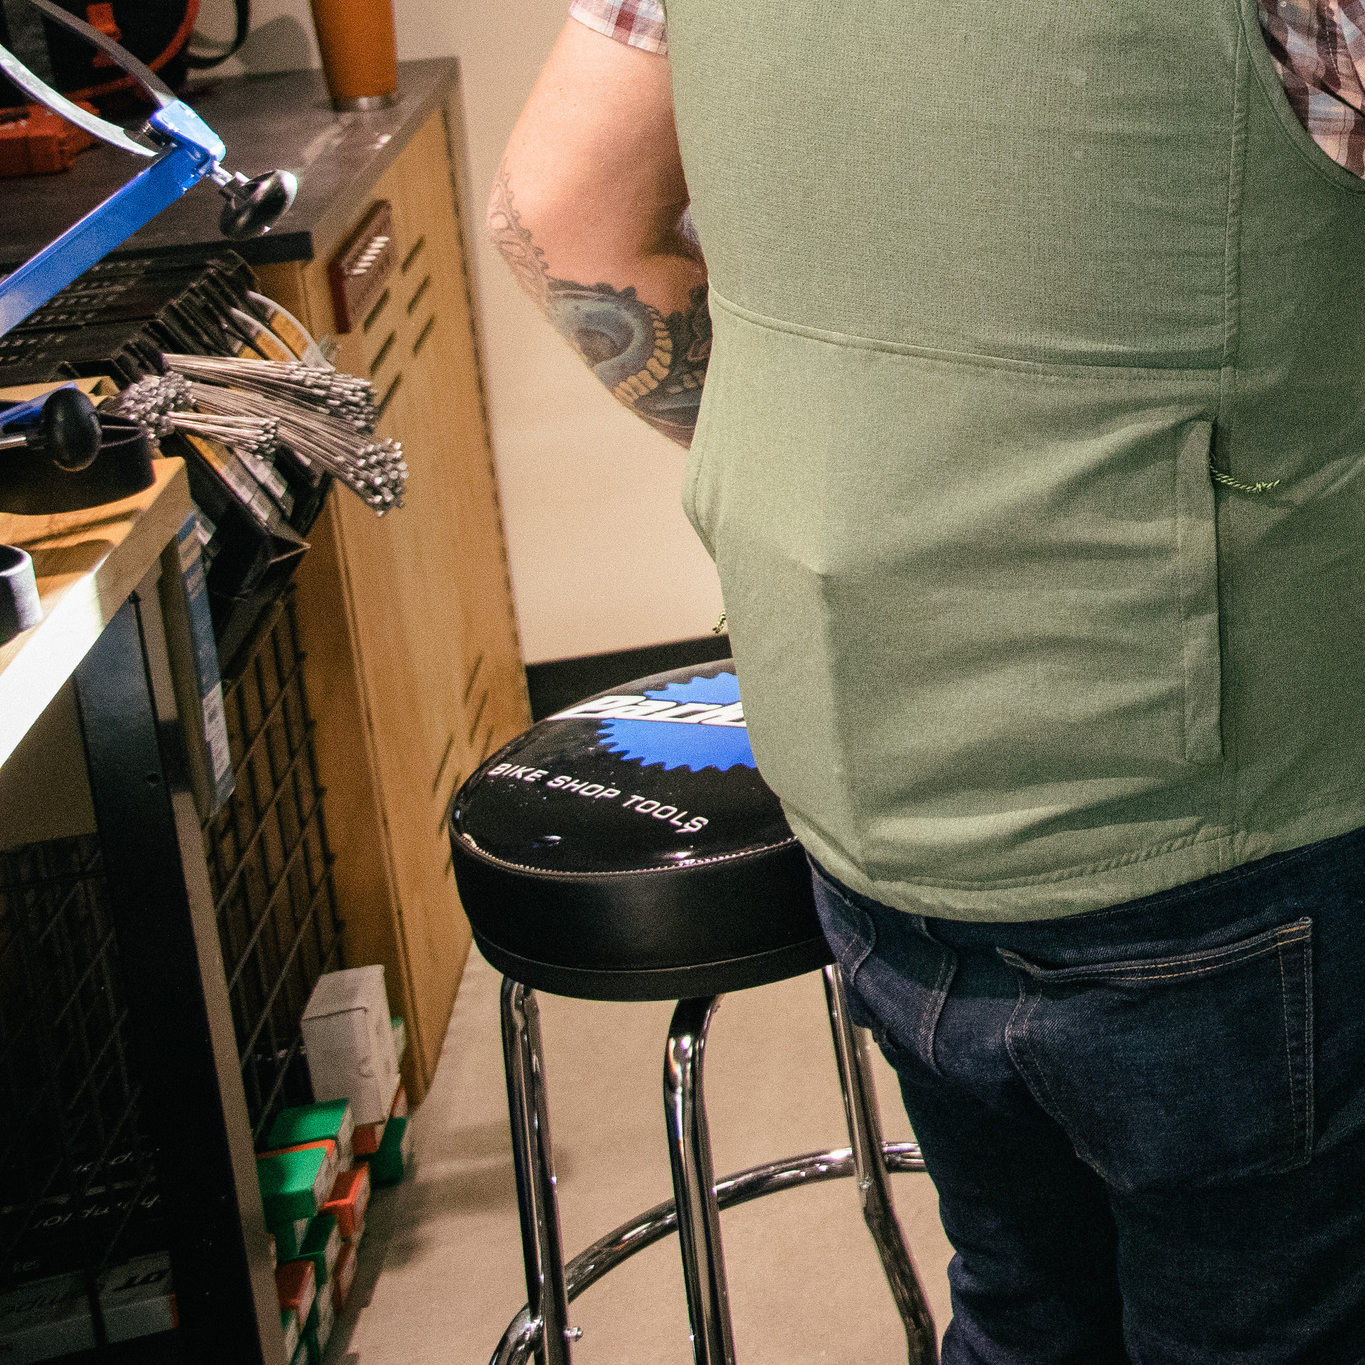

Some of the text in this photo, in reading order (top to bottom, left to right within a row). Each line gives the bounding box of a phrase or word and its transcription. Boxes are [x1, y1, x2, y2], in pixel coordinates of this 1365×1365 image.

[488, 762, 709, 834] BIKE SHOP TOOLS
